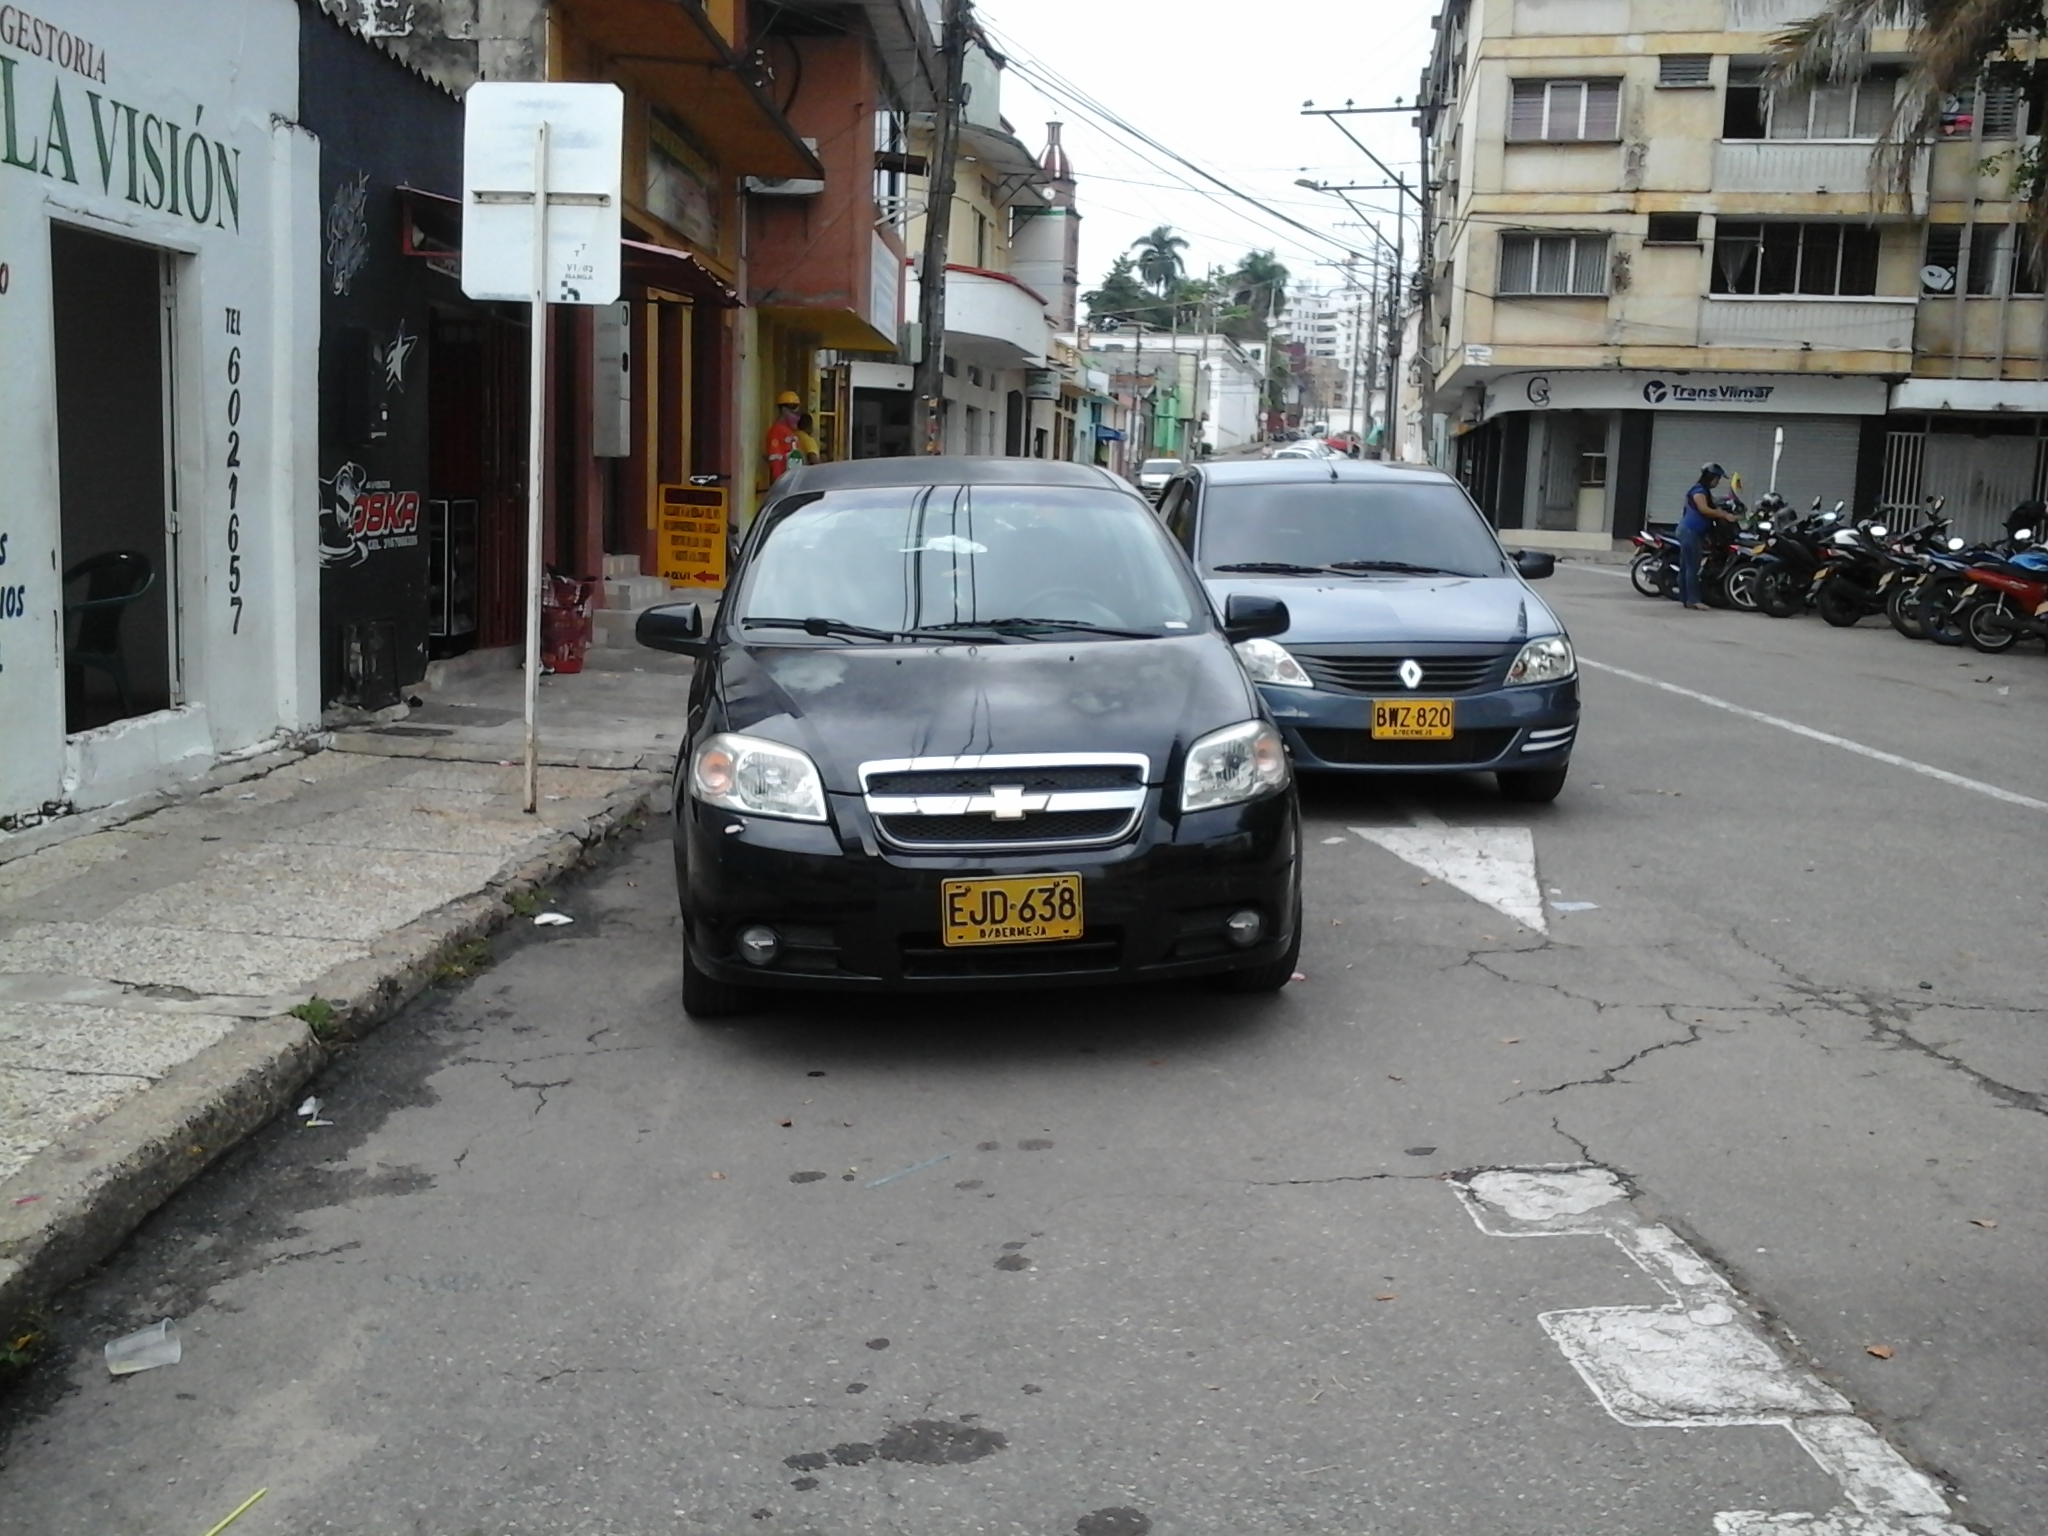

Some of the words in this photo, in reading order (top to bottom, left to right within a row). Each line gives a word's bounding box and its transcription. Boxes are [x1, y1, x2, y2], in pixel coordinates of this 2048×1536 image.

[0, 4, 106, 84] GESTORIA
[0, 54, 79, 185] LA
[86, 103, 241, 236] VISIÓN
[225, 307, 241, 336] TEL
[979, 926, 1048, 939] B/BERMEJA
